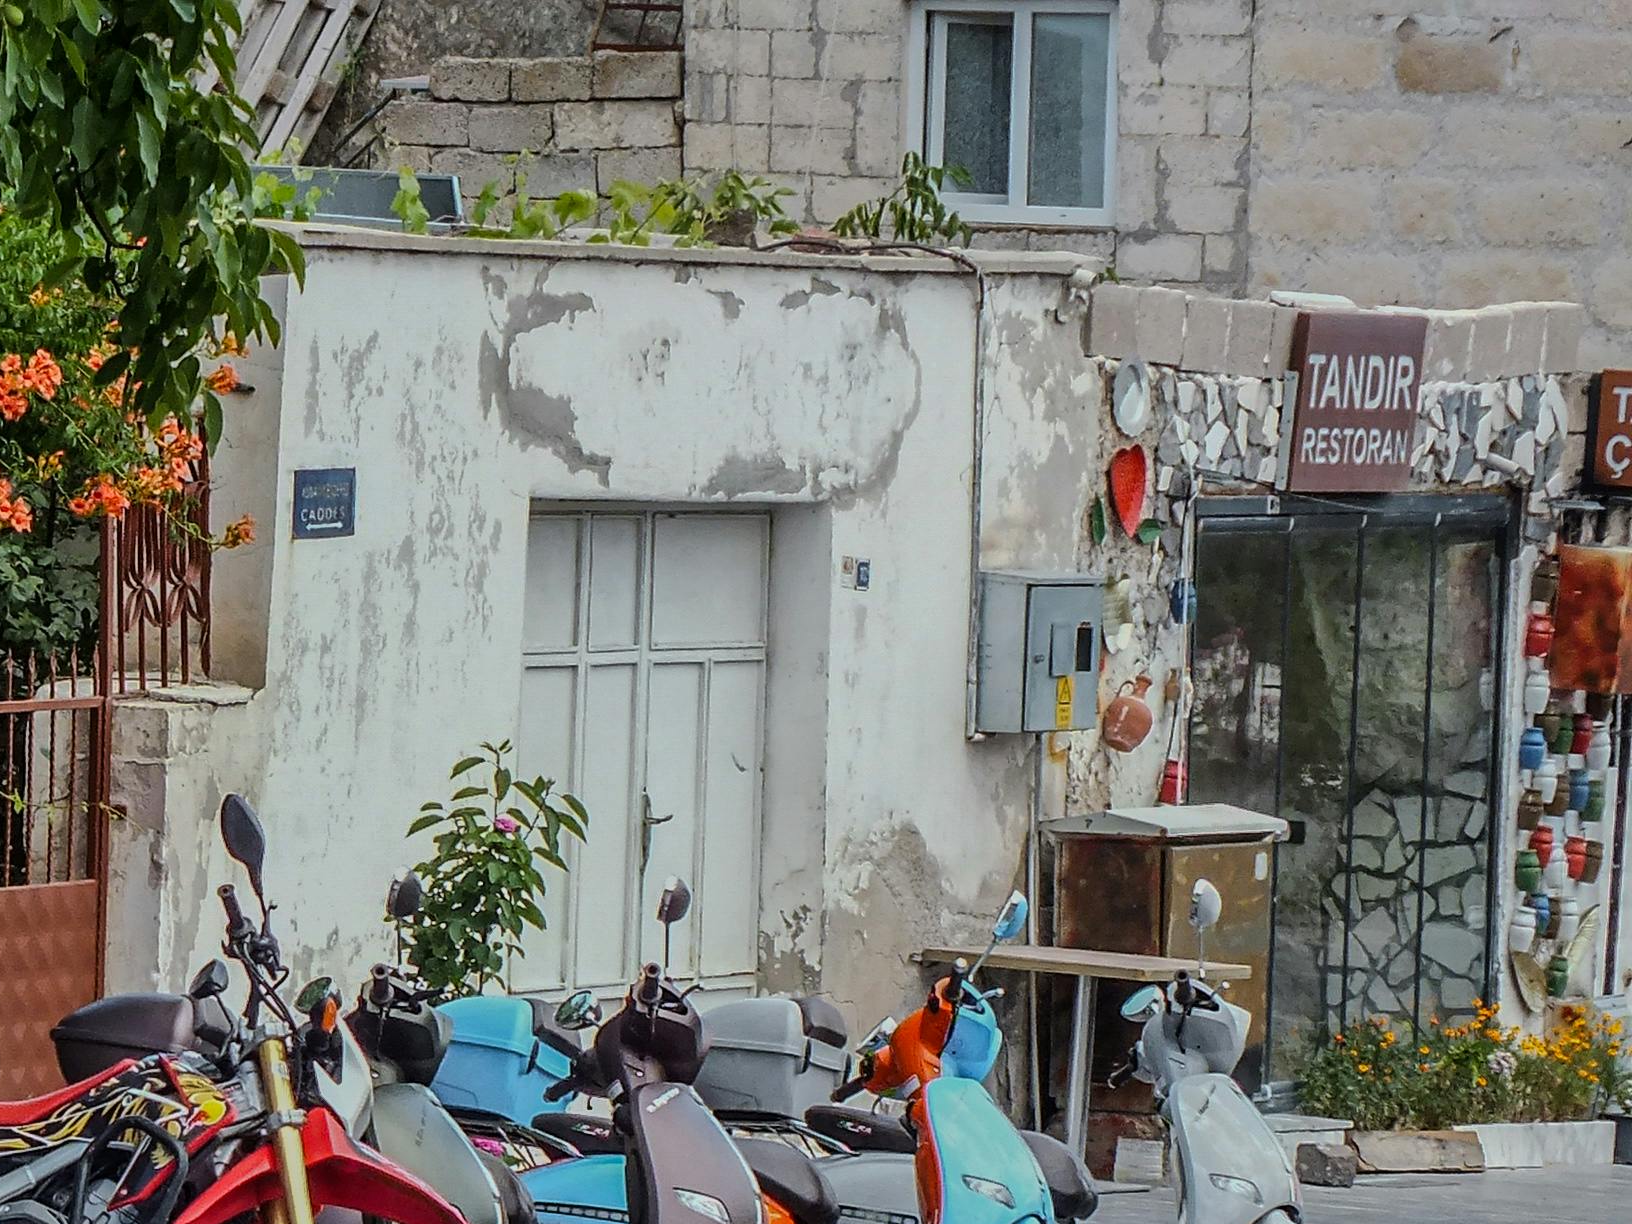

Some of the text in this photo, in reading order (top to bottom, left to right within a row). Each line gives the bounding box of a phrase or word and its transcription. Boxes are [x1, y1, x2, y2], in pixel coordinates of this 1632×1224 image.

[1309, 354, 1414, 410] TANDIR
[1612, 386, 1632, 424] T
[1301, 427, 1409, 466] RESTORAN
